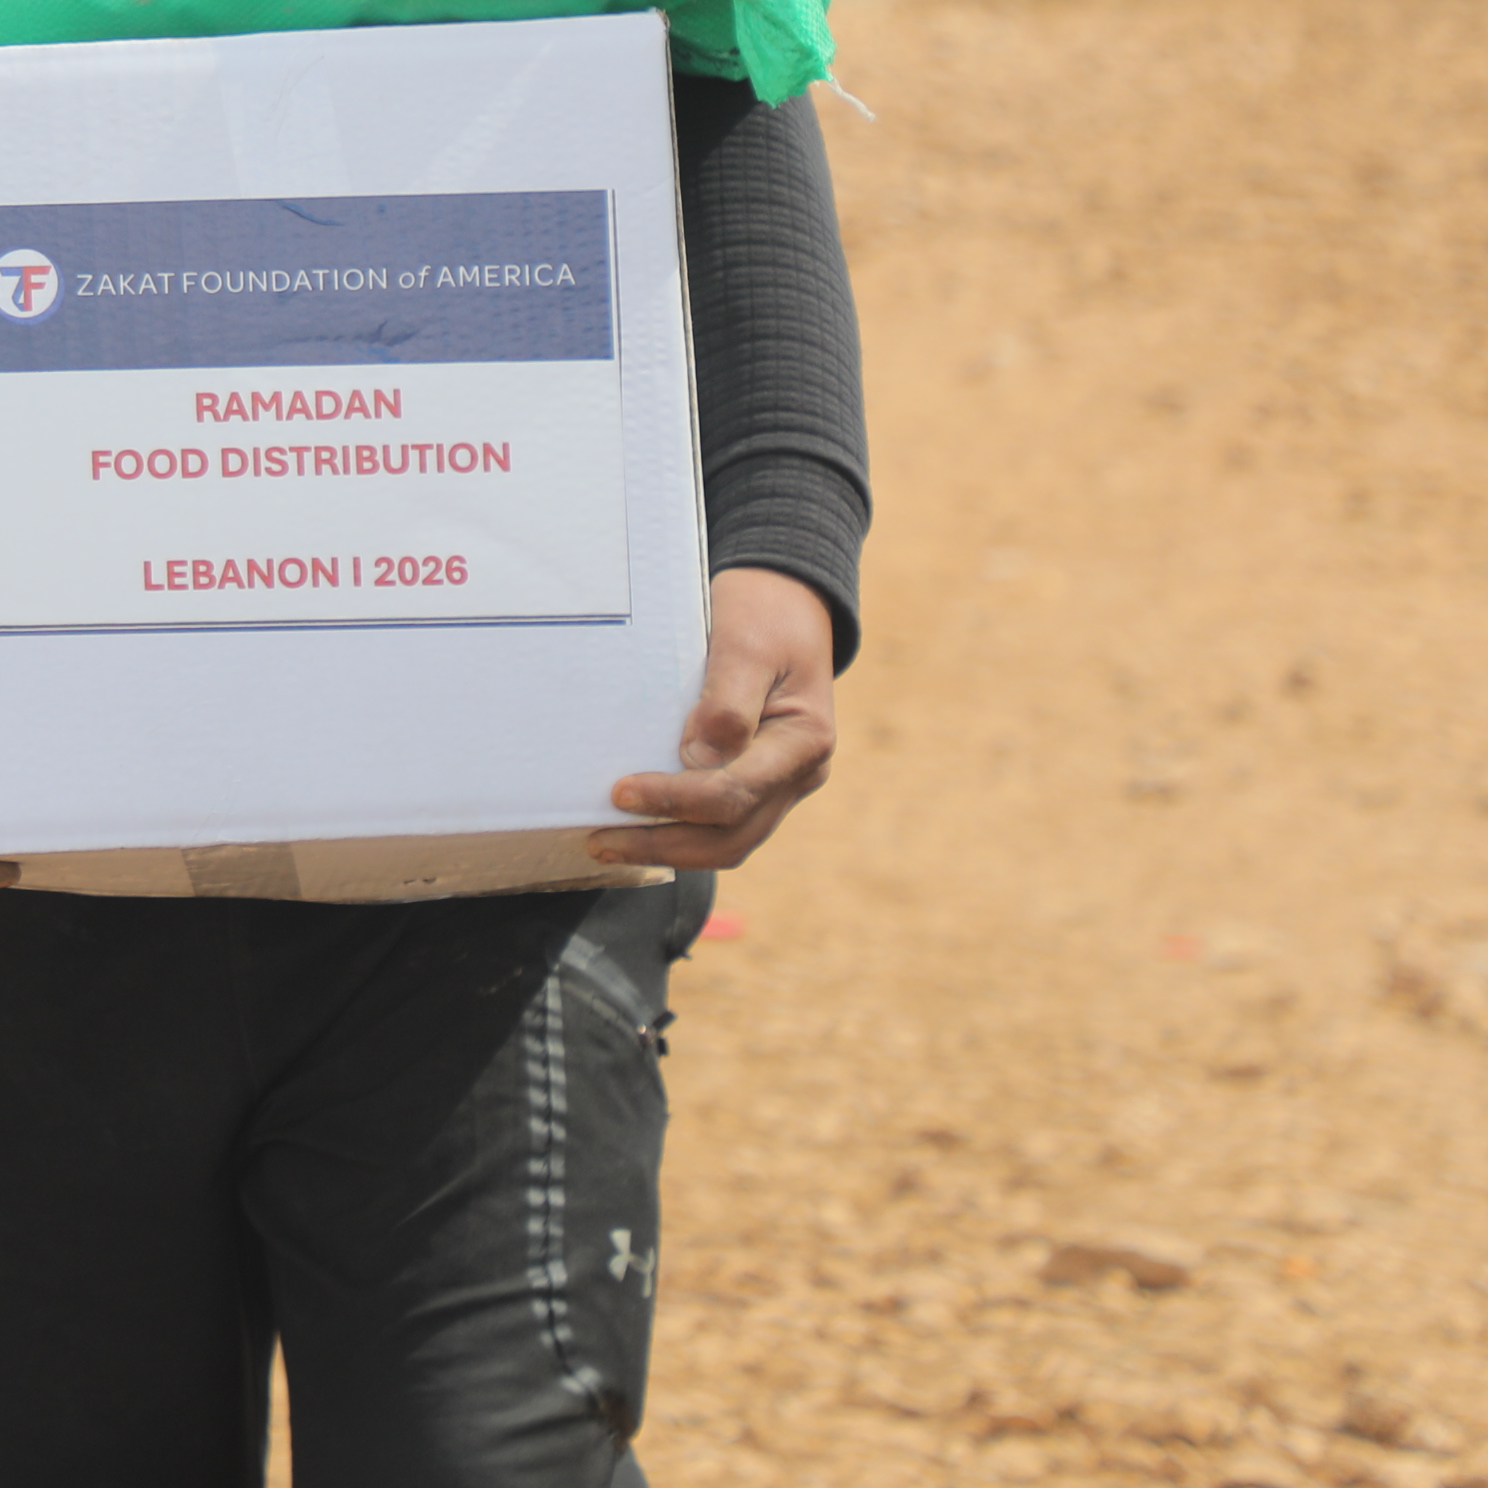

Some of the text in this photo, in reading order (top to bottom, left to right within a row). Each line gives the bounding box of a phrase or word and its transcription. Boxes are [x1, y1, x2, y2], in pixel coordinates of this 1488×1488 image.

[76, 263, 576, 296] ZAKAT FOUNDATION of AMERICA
[194, 388, 403, 423] RAMADAN
[90, 442, 511, 481] FOOD DISTRIBUTION
[143, 556, 340, 591] LEBANON
[373, 554, 469, 587] 2026
